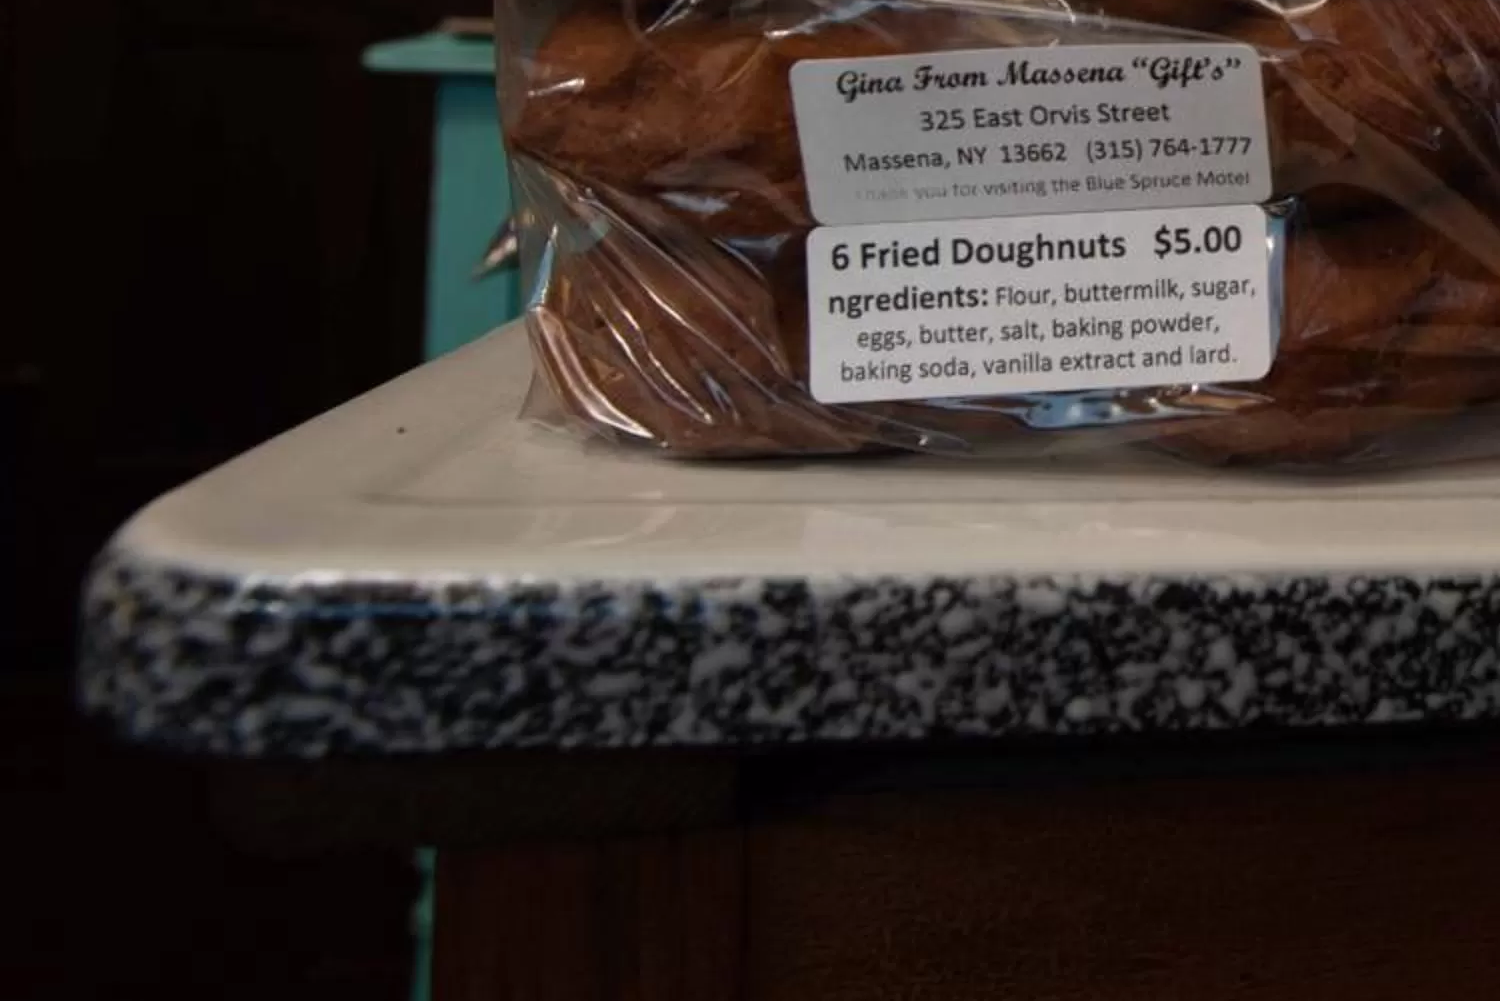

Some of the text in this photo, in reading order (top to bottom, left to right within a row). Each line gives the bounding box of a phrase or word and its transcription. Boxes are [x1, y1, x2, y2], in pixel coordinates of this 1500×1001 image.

[836, 71, 904, 103] Gina
[913, 65, 988, 90] From
[997, 61, 1124, 86] Massena
[920, 103, 1170, 131] 325 East Orvis Street
[843, 136, 1251, 172] Massena, NY 13662 (315) 764-1777
[983, 180, 1047, 197] visiting
[1051, 178, 1081, 194] the
[1086, 175, 1126, 191] Blue
[1129, 174, 1192, 192] Spruce
[1196, 171, 1249, 187] Motel
[832, 225, 1241, 271] 6 Fried Doughnuts $5.00
[996, 286, 1056, 307] Flour,
[1064, 279, 1184, 303] buttermilk,
[1191, 279, 1255, 301] sugar,
[857, 313, 1219, 352] eggs, butter, salt, baking powder,
[841, 343, 1236, 384] baking soda, vanilla extract and lard.
